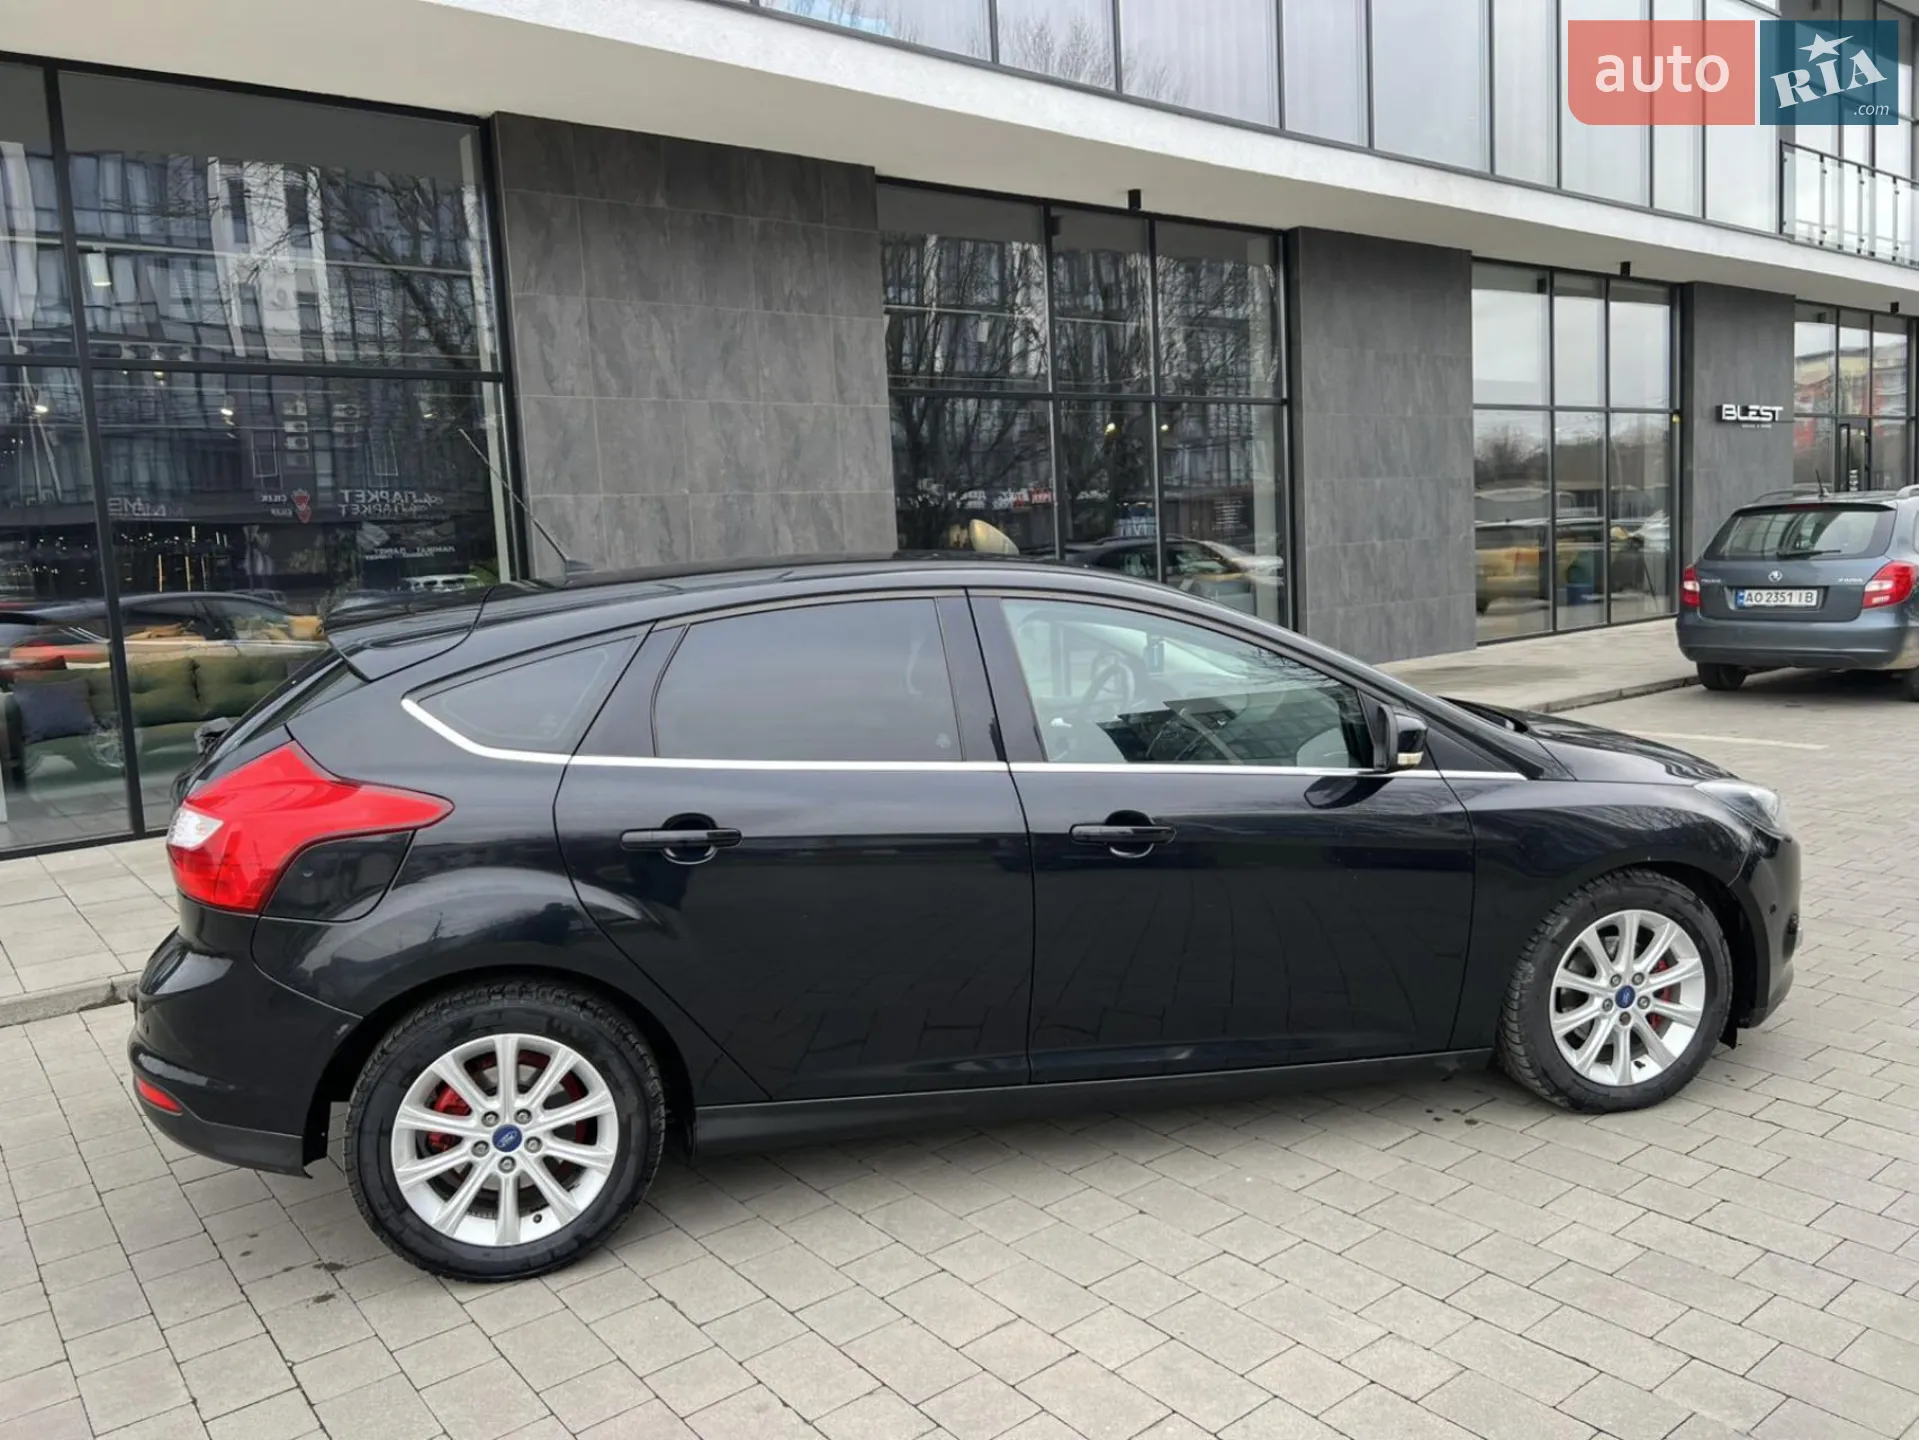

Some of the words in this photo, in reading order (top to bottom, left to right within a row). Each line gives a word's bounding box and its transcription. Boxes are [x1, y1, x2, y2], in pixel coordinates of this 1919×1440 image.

[1722, 404, 1784, 421] BLEST
[1745, 592, 1763, 603] AO
[1766, 592, 1793, 603] 2351
[1798, 592, 1813, 603] IB
